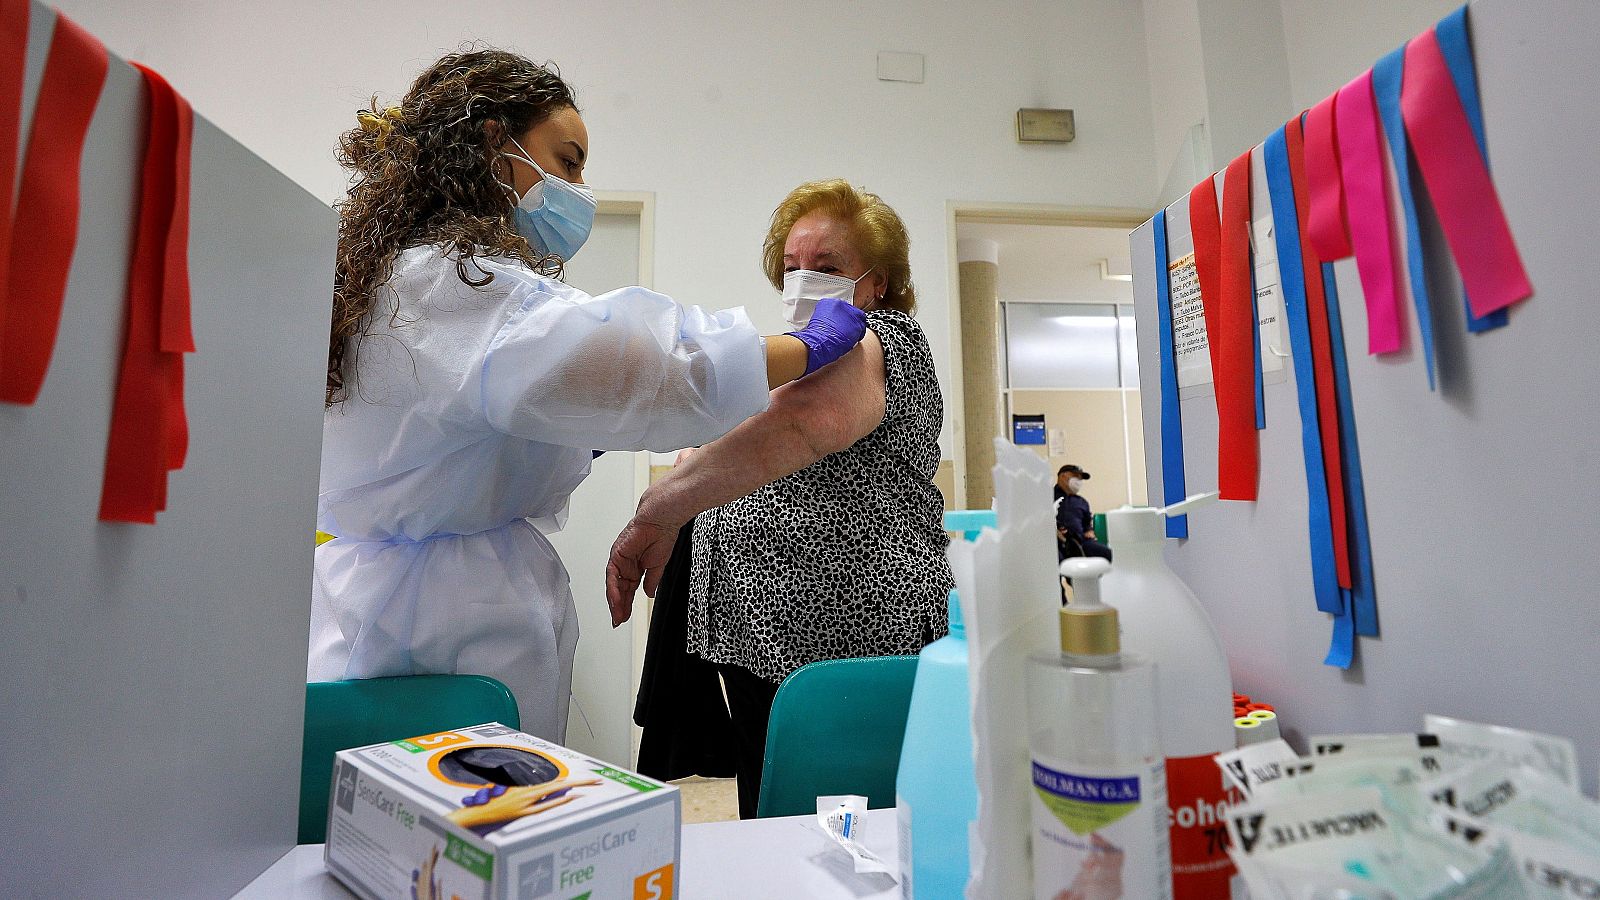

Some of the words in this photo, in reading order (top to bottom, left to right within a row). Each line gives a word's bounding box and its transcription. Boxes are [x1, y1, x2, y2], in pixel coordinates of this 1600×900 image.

[357, 779, 395, 818] SensiCare
[395, 801, 416, 832] Free
[560, 826, 638, 868] SensiCare
[560, 864, 595, 890] Free
[645, 872, 663, 900] S
